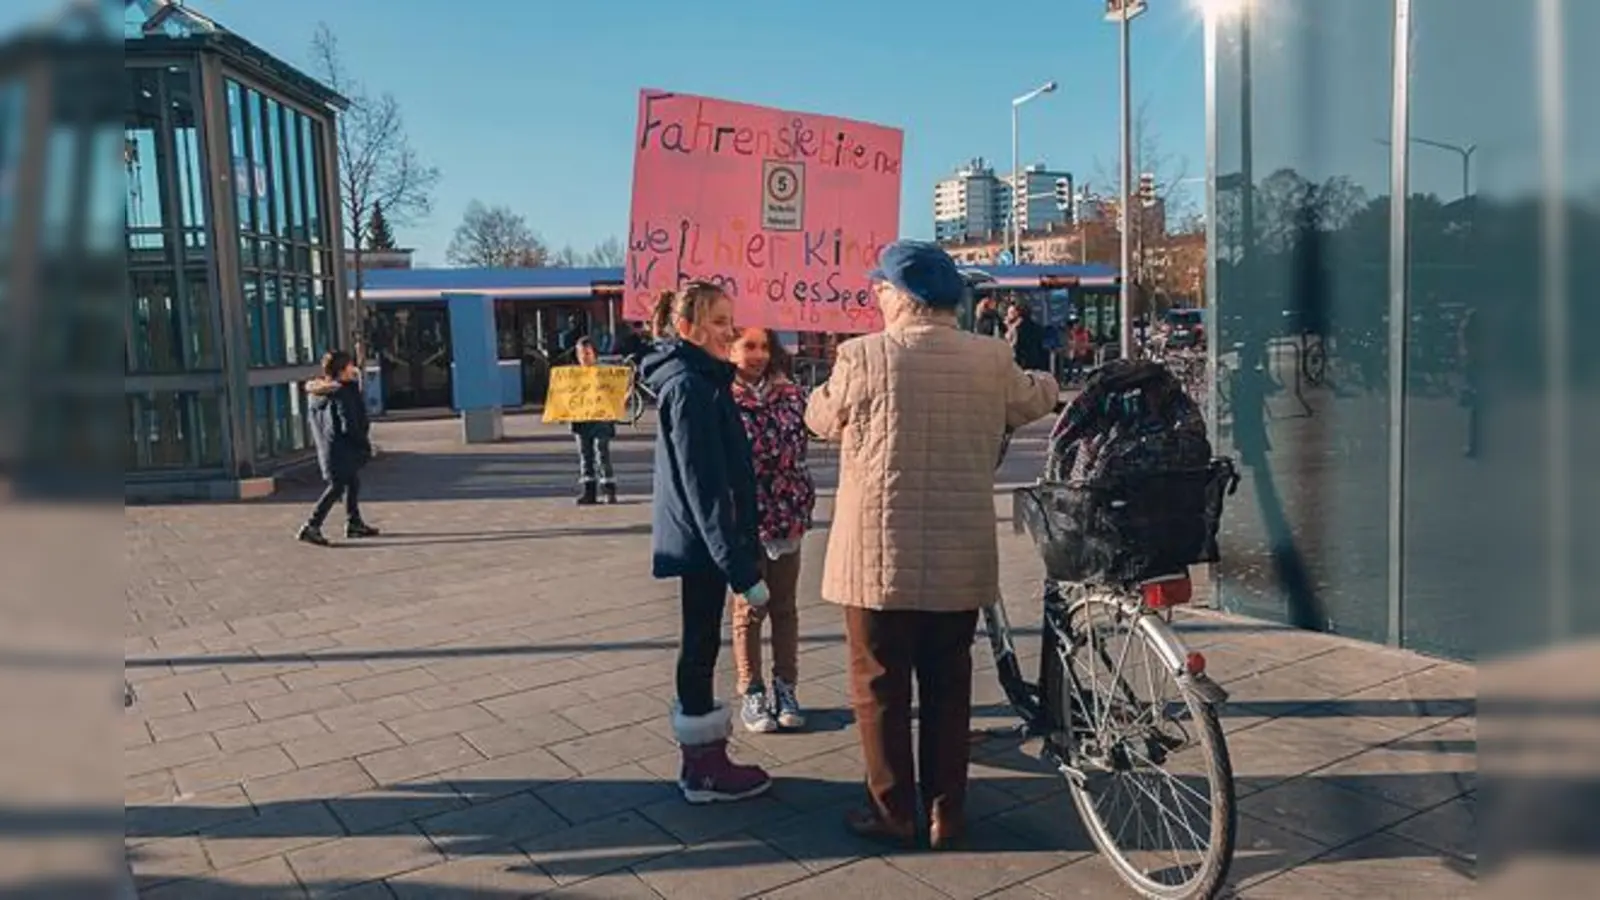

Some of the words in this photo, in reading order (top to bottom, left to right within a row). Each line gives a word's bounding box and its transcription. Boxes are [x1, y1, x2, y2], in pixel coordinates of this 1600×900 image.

[640, 92, 770, 156] Fahren
[777, 175, 788, 192] 5
[714, 218, 788, 269] hier
[793, 279, 822, 303] es
